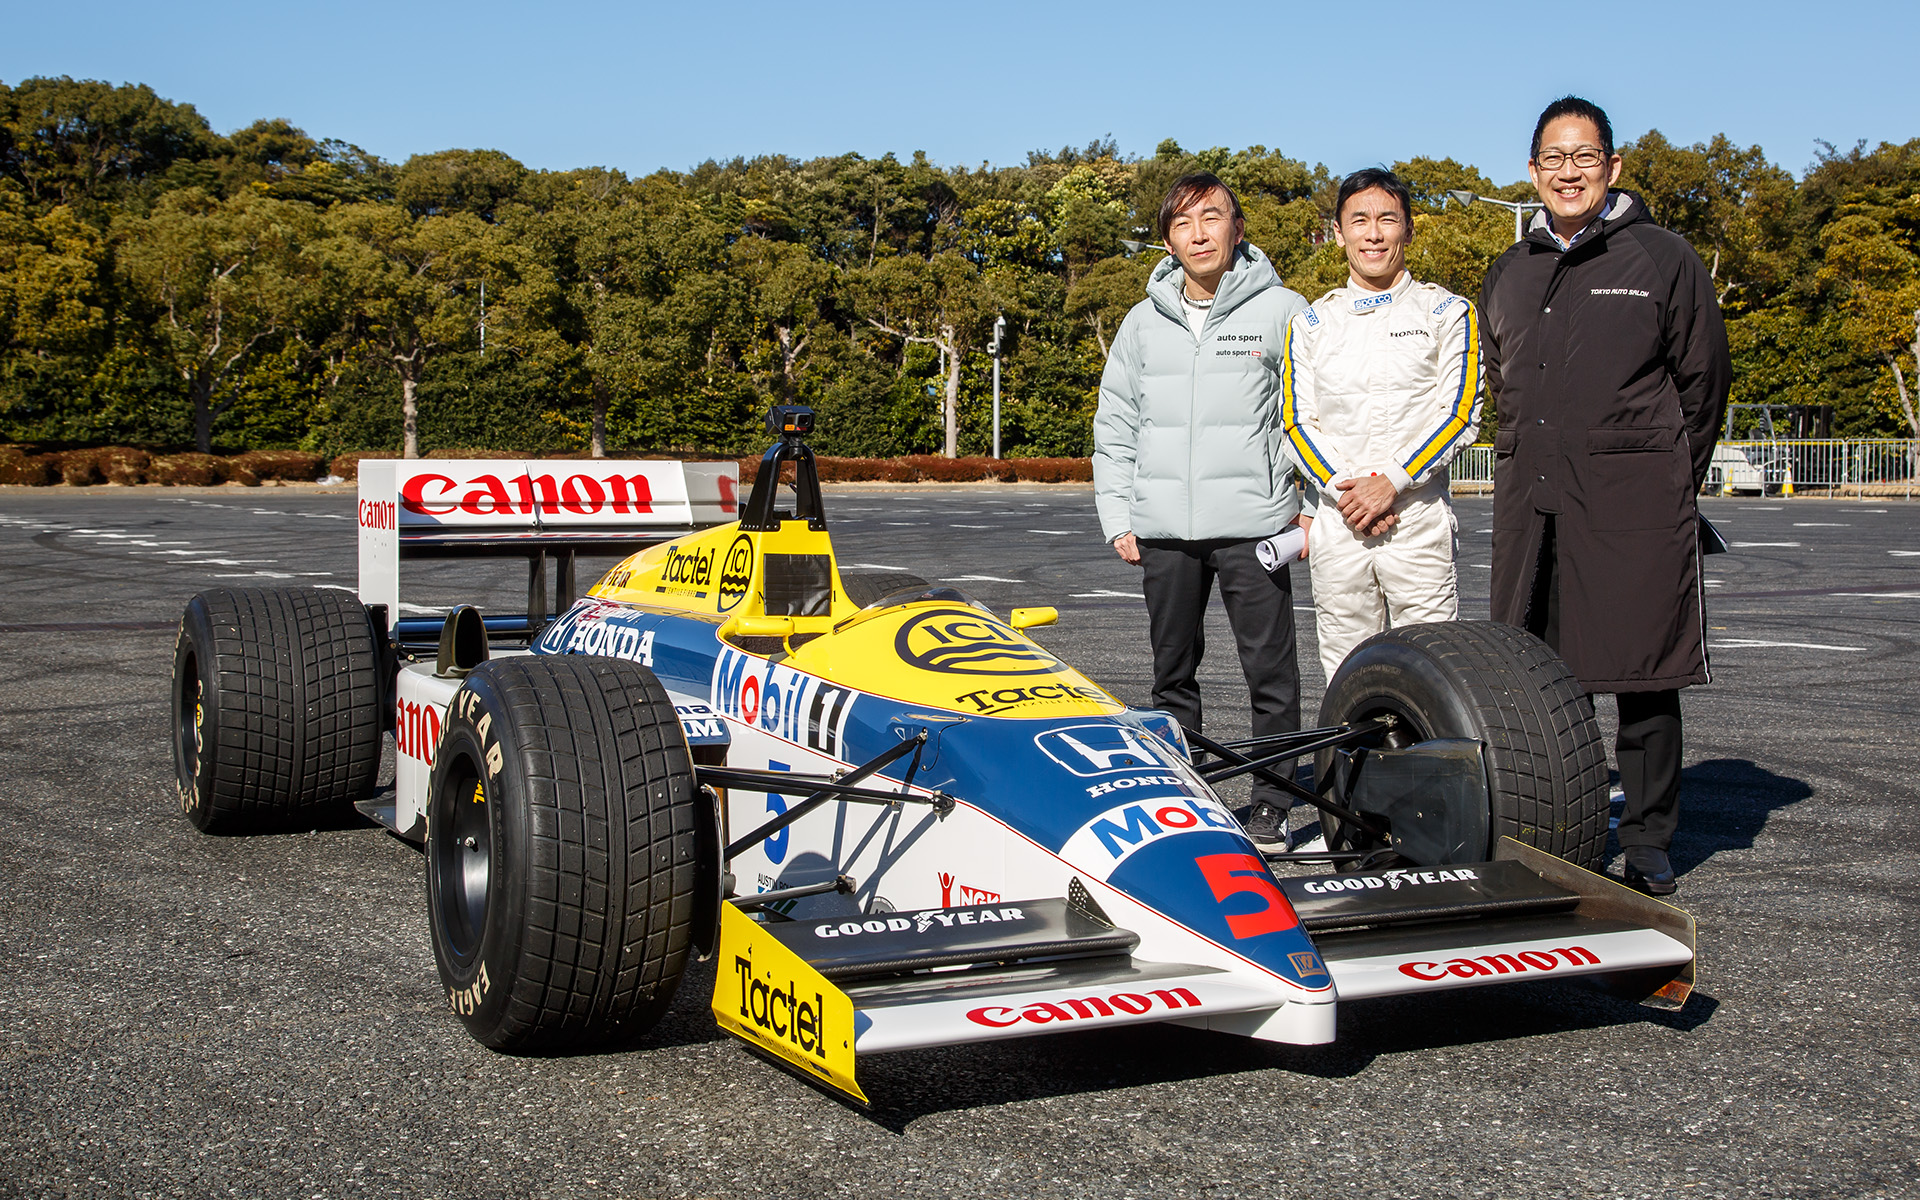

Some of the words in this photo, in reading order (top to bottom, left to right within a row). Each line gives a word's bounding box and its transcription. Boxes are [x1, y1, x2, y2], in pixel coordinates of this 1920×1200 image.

[1628, 289, 1650, 298] SALON
[1238, 334, 1263, 343] sport
[1389, 329, 1430, 338] HONDA
[1231, 349, 1251, 357] sport
[402, 473, 653, 516] Canon
[661, 545, 716, 586] Tactel
[729, 548, 749, 574] ICI
[567, 620, 656, 668] HONDA
[921, 622, 1015, 645] ICI
[716, 649, 810, 743] Mobil
[818, 688, 842, 751] 1
[955, 683, 1108, 712] Tacte
[1085, 776, 1206, 799] HONDA
[764, 759, 791, 865] 5
[1090, 799, 1240, 860] Mob
[757, 872, 778, 891] AUSTIN
[962, 888, 1000, 906] NGK
[1194, 853, 1299, 940] 5
[1304, 876, 1385, 894] GOOD
[1400, 869, 1479, 885] YEAR
[814, 917, 912, 938] GOOD
[933, 907, 1026, 927] YEAR
[1397, 946, 1602, 982] Canon
[449, 960, 491, 1016] EAGLE
[735, 954, 826, 1060] Tactel
[966, 987, 1203, 1028] Canon
